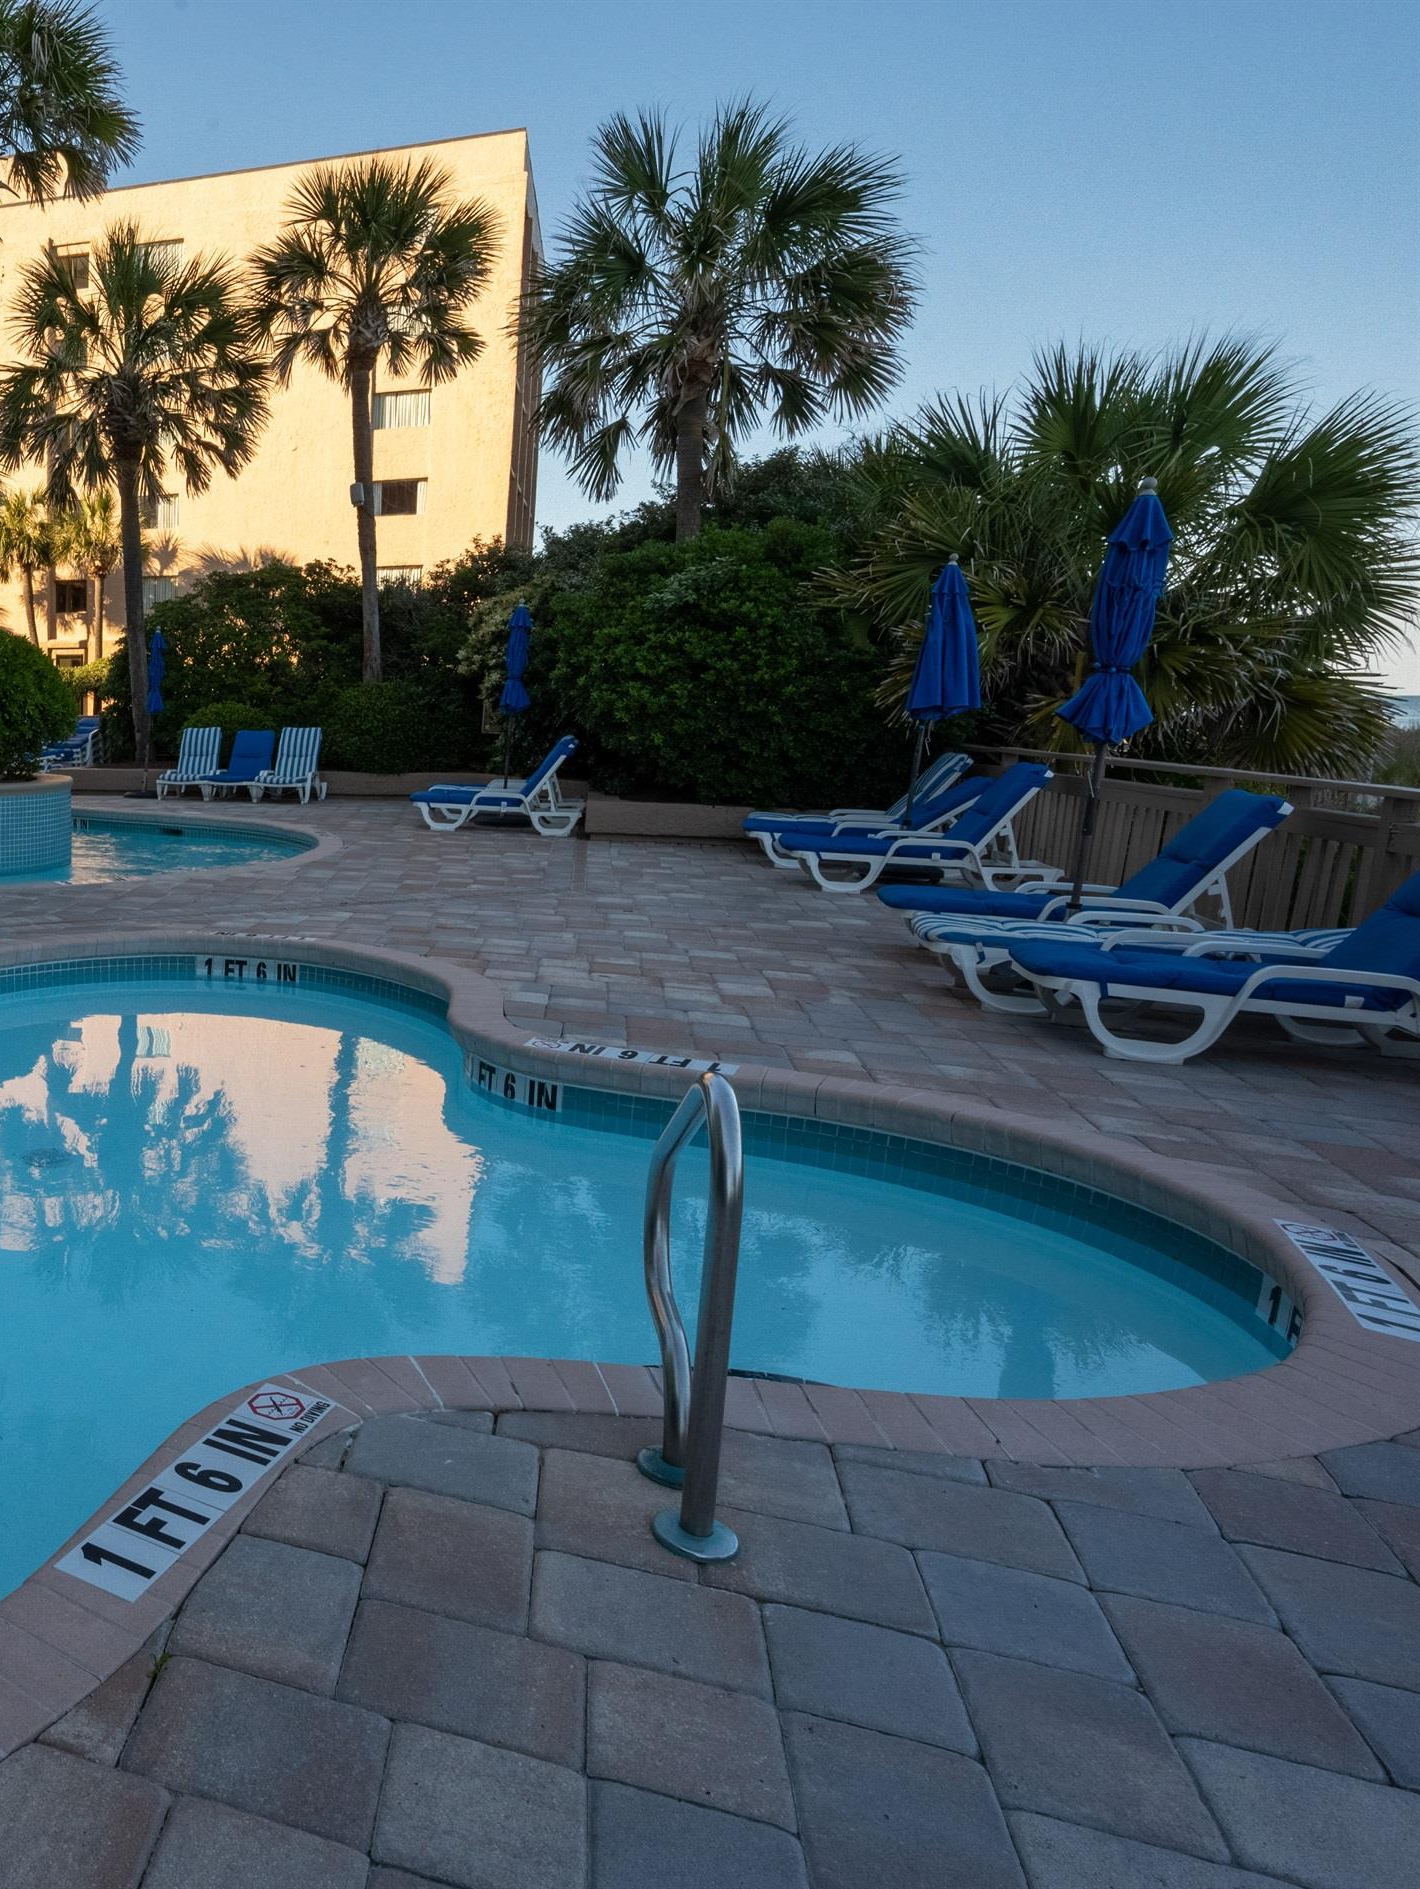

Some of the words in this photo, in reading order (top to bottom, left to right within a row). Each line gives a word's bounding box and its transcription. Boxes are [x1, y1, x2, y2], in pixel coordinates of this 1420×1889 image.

[204, 958, 213, 976] 1
[224, 960, 247, 977] FT
[256, 961, 267, 979] 6
[277, 963, 297, 982] IN
[568, 1043, 607, 1055] IN
[618, 1050, 639, 1060] 6
[649, 1055, 692, 1068] FT
[478, 1060, 497, 1092] FT
[504, 1071, 516, 1100] 6
[528, 1079, 558, 1111] IN
[1294, 1239, 1378, 1268] IN
[1318, 1264, 1393, 1285] 6
[1266, 1285, 1282, 1326] 1
[1330, 1279, 1420, 1319] FT
[288, 1421, 309, 1434] NO
[300, 1401, 331, 1424] DIVING
[202, 1418, 293, 1467] IN
[174, 1461, 243, 1494] 6
[112, 1487, 211, 1550] FT
[81, 1542, 157, 1580] 1
